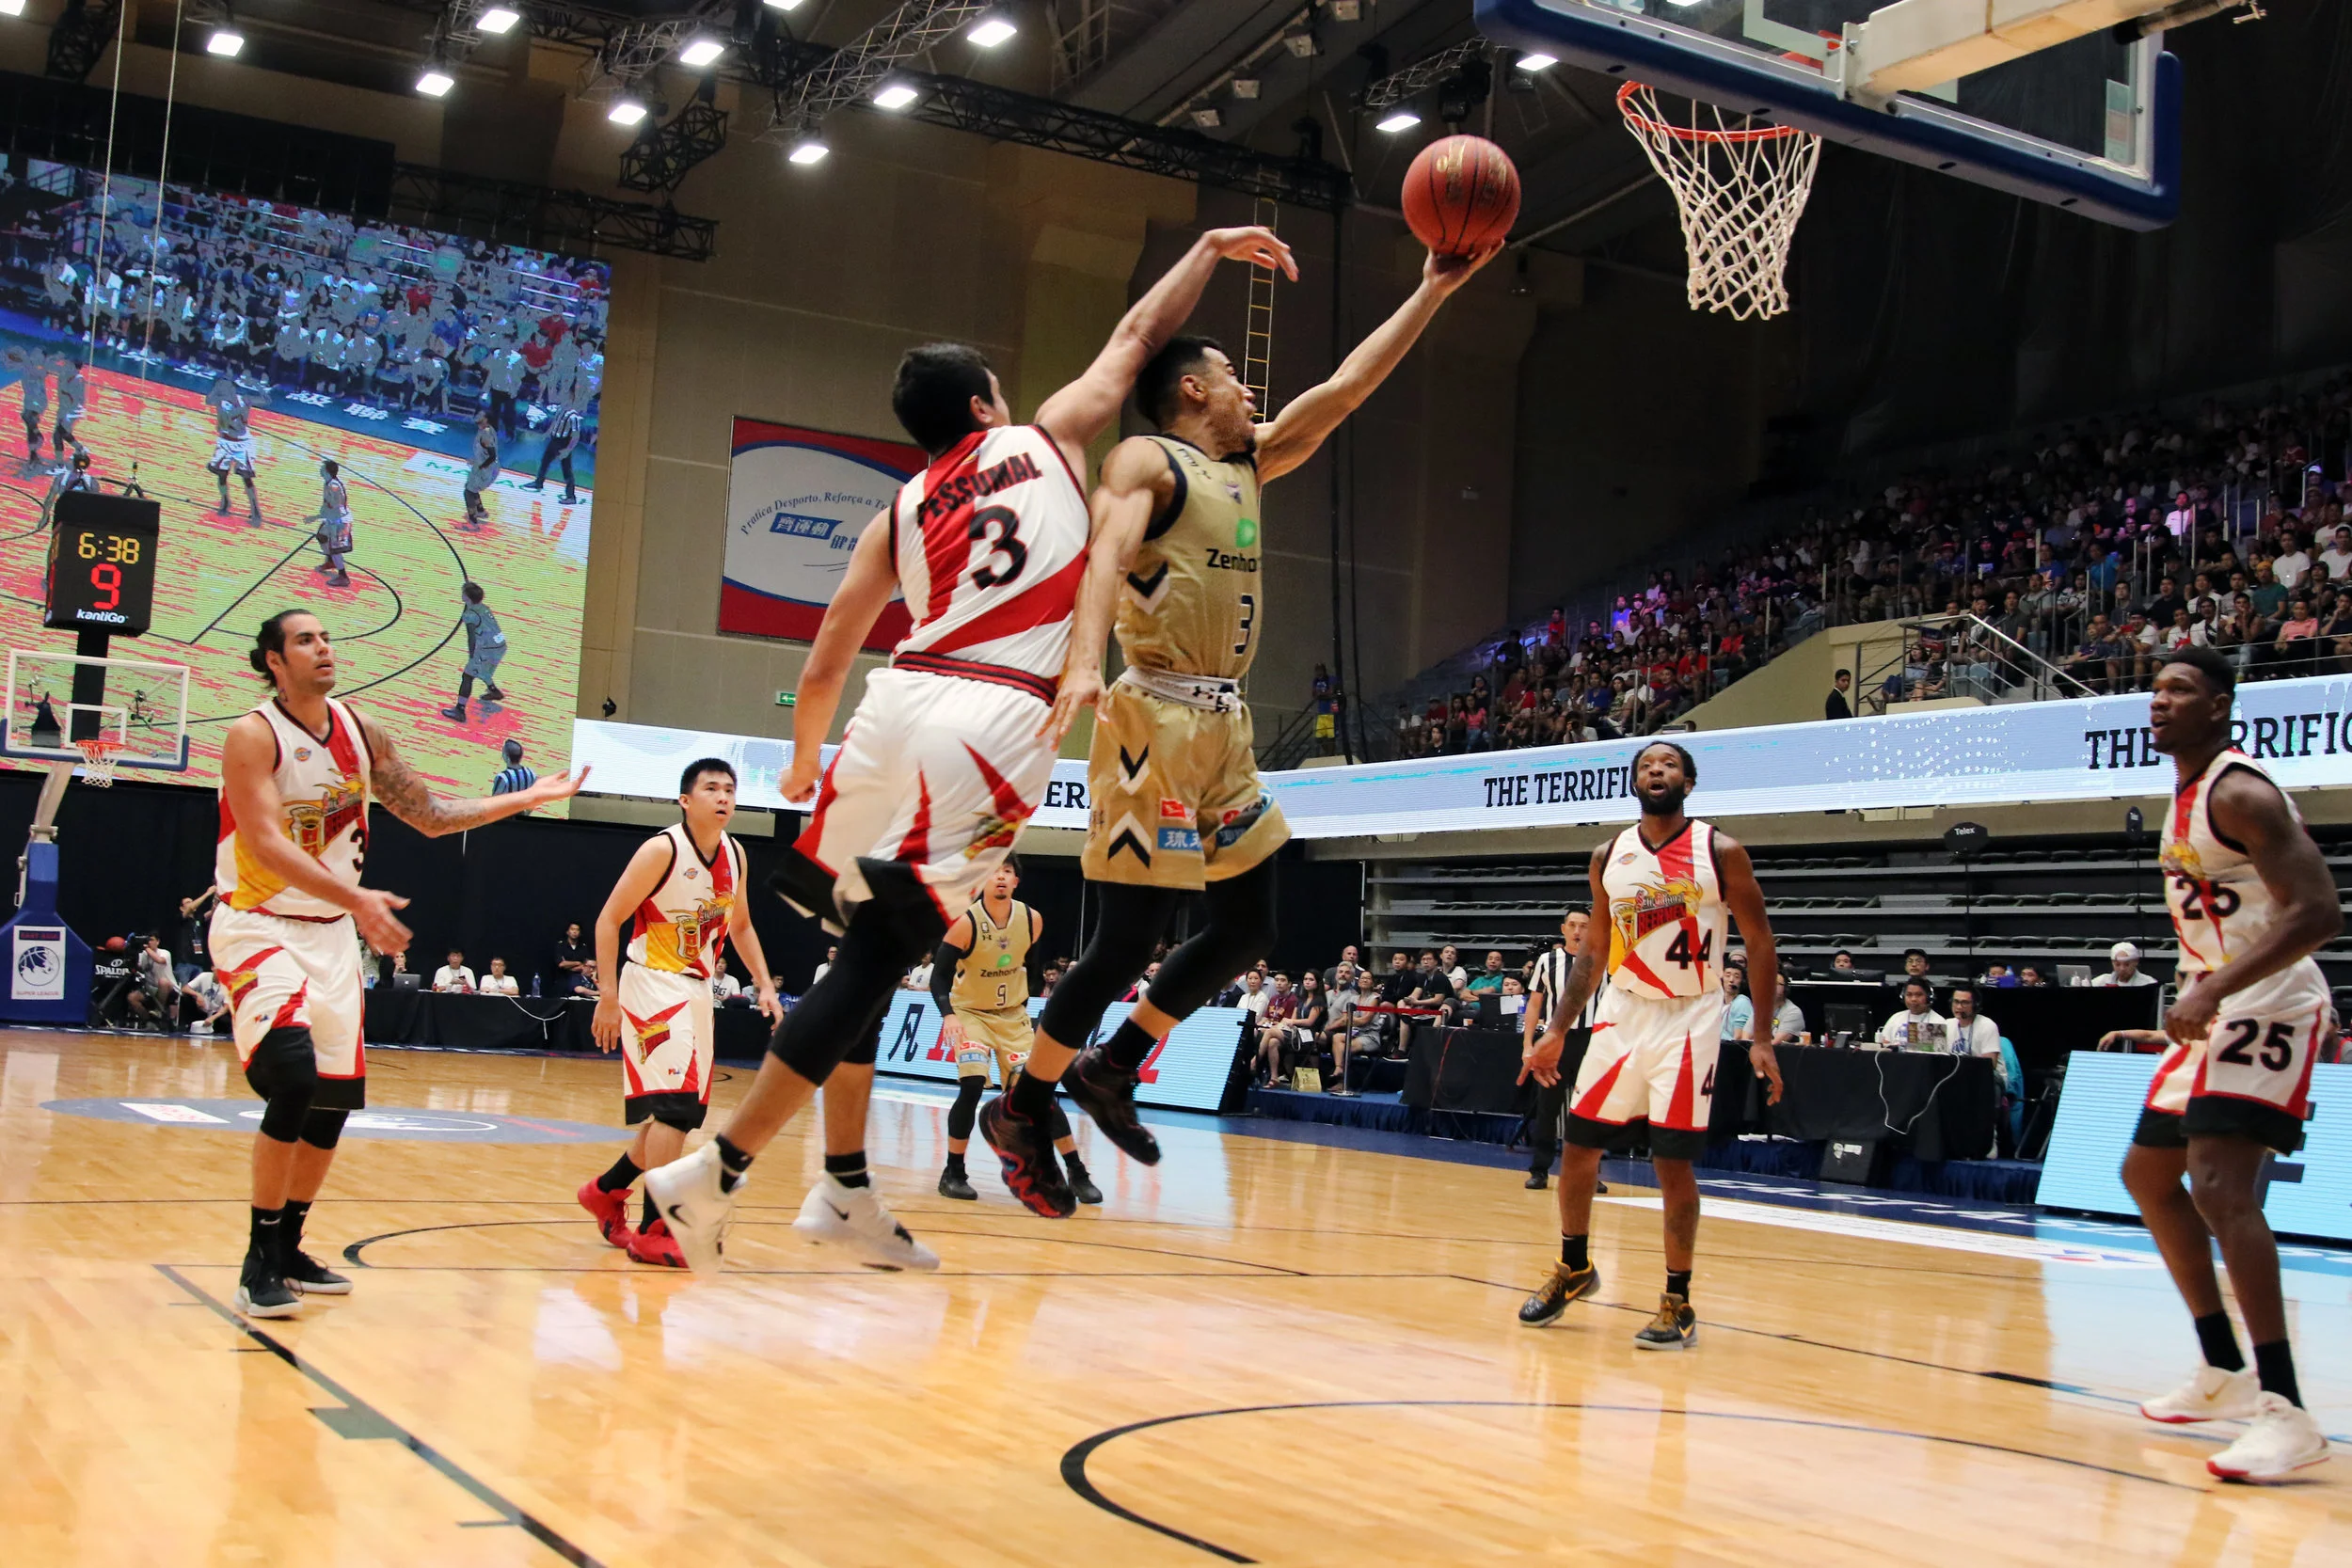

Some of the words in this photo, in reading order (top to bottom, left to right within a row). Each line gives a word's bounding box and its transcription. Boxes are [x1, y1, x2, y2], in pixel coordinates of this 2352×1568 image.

[78, 532, 140, 564] 6:38
[967, 504, 1028, 592] 3
[1205, 548, 1263, 573] Zenho
[90, 562, 121, 610] 9
[76, 609, 126, 624] kantiGo
[1234, 593, 1254, 656] 3
[2085, 727, 2160, 769] THE
[1484, 775, 1529, 807] THE
[1953, 827, 1976, 835] Telex
[2175, 875, 2242, 921] 25
[1664, 928, 1713, 970] 44
[996, 984, 1007, 1006] 9
[2217, 1018, 2296, 1072] 25
